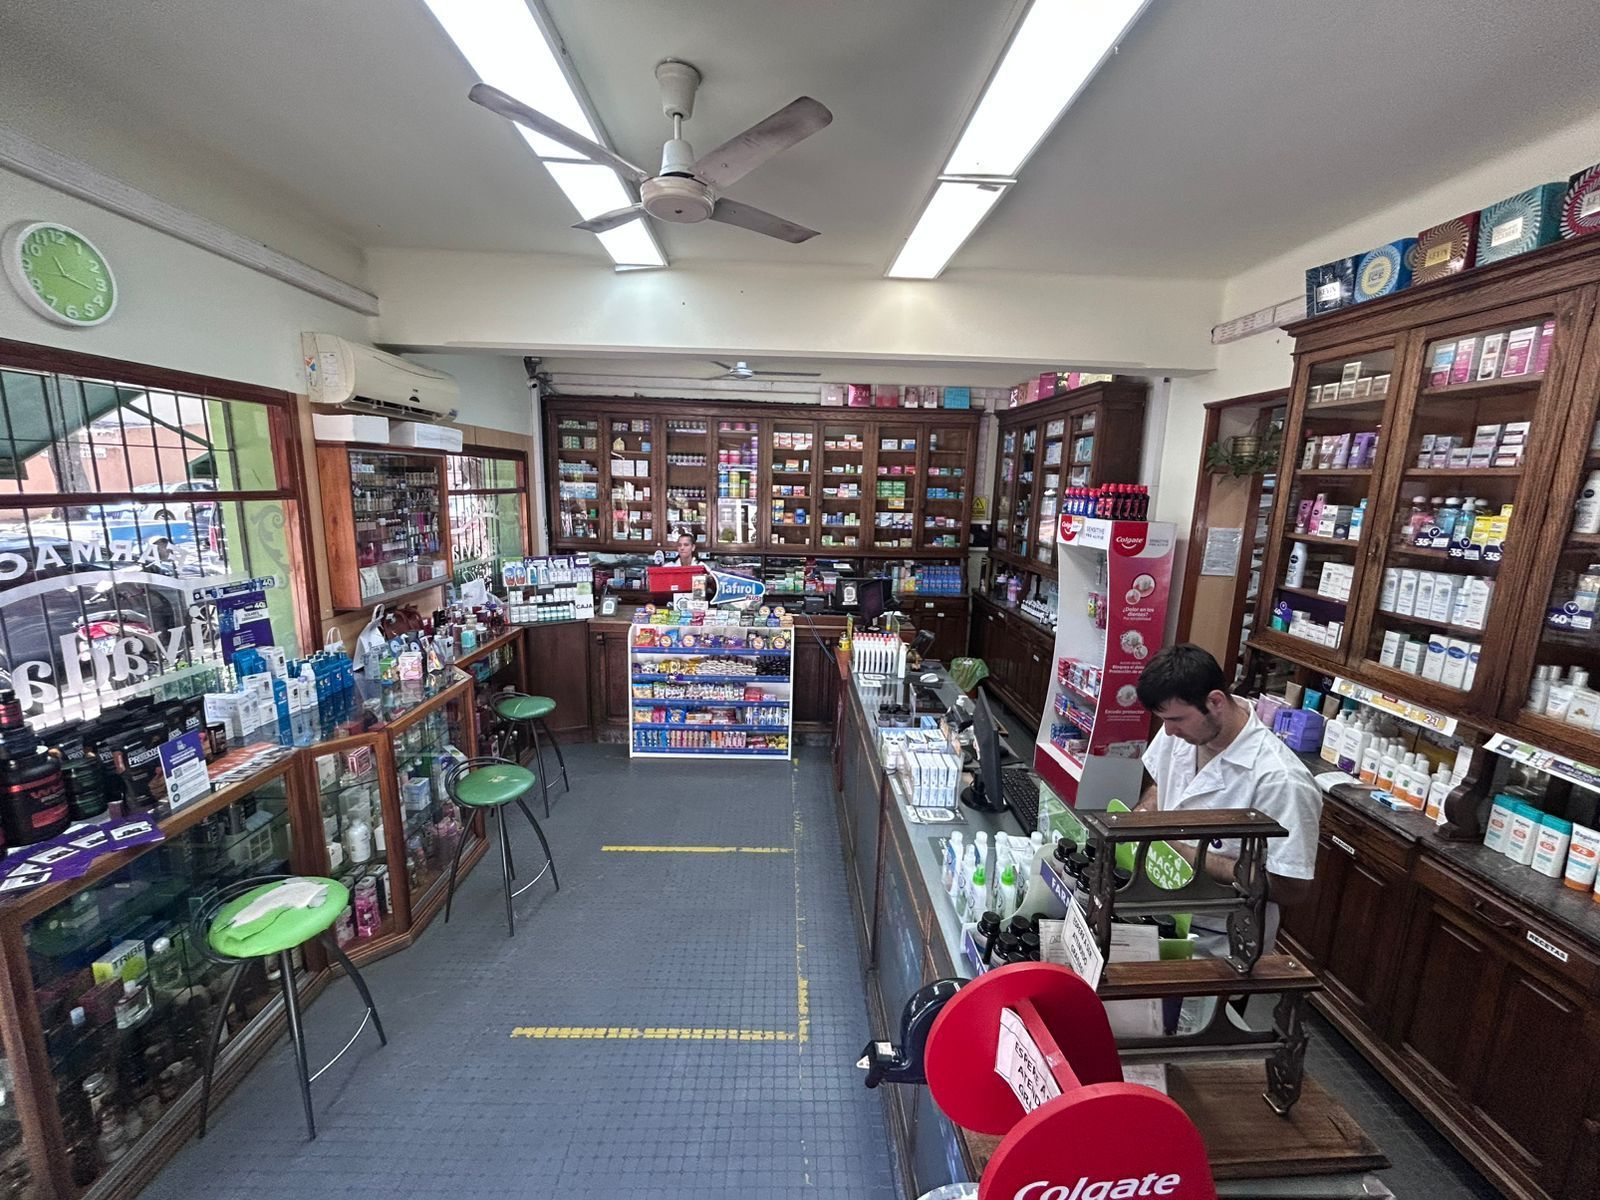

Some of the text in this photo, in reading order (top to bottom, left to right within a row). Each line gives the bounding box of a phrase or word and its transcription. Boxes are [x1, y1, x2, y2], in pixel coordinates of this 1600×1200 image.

[45, 294, 58, 308] 7
[92, 294, 105, 308] 4
[65, 304, 80, 319] 6
[84, 303, 96, 318] 5
[1115, 535, 1145, 546] Colgate
[719, 581, 756, 595] Tafirol
[1529, 934, 1566, 959] RECETAS
[112, 942, 145, 969] TRIBE
[1014, 1042, 1040, 1085] ESPERE
[1013, 1171, 1182, 1200] Colgate
